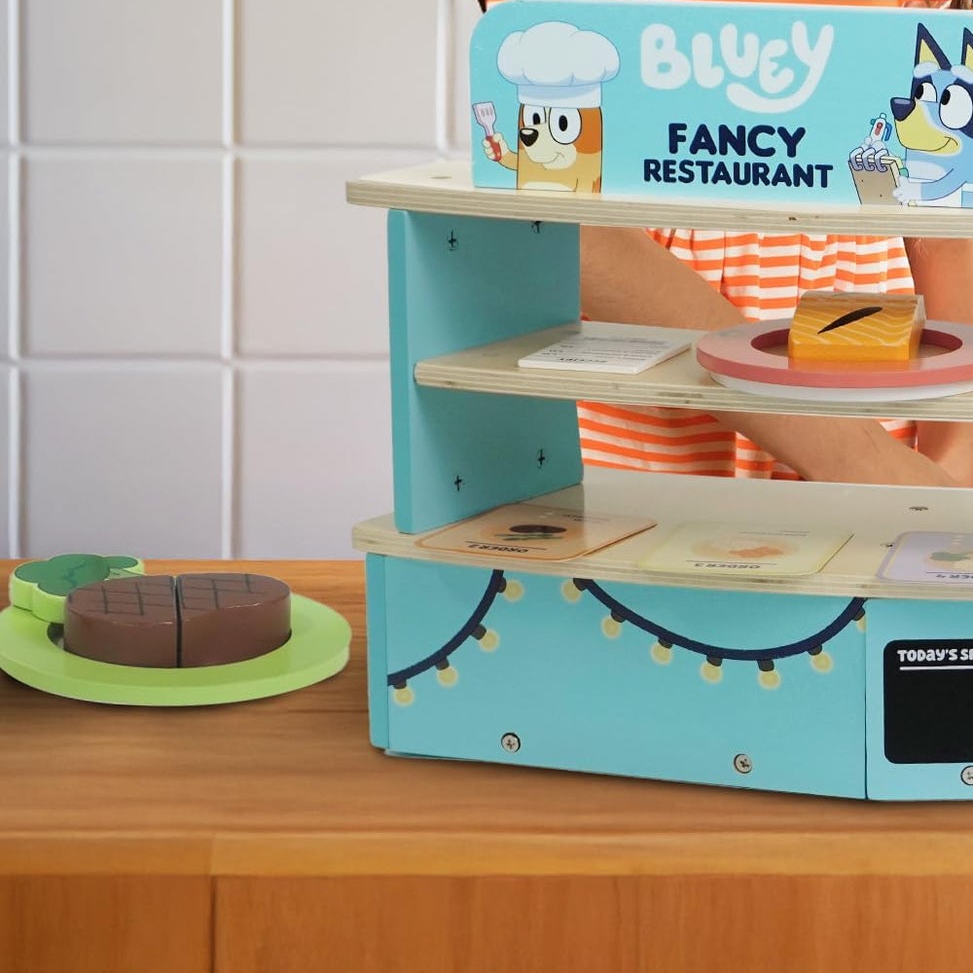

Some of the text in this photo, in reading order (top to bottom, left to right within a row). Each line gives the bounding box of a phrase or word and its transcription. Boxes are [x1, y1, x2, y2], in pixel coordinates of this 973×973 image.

[640, 20, 835, 114] BLUEY
[668, 123, 806, 158] FANCY
[643, 159, 834, 188] RESTAURANT
